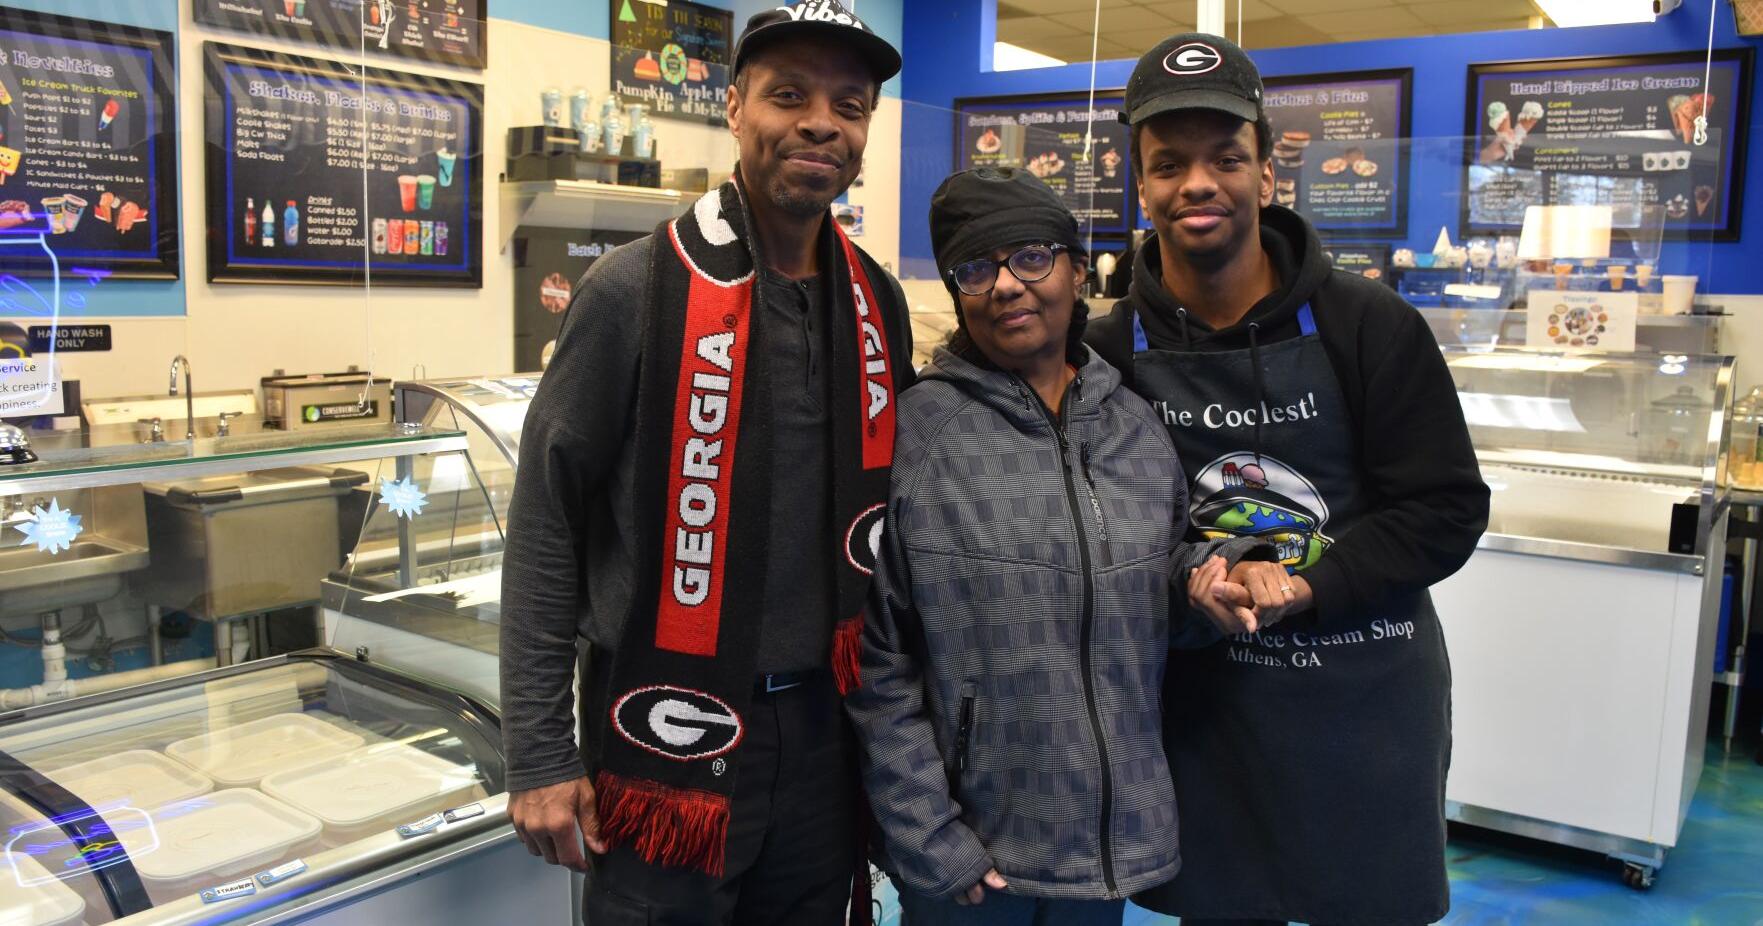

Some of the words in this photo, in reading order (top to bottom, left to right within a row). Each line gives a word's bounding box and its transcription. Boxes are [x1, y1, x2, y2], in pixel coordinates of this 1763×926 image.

[22, 78, 36, 88] Ice
[39, 79, 69, 90] Cream
[71, 83, 96, 94] Truck
[97, 86, 138, 99] Favorites
[680, 82, 713, 102] Apple
[1510, 80, 1551, 96] Hand
[1554, 78, 1609, 95] Dipped
[1612, 78, 1638, 91] Ice
[1642, 76, 1700, 89] Cream
[383, 99, 396, 115] &
[400, 102, 451, 122] Drinks
[656, 99, 675, 113] Pie
[681, 100, 692, 113] of
[37, 137, 61, 145] Cream
[237, 150, 258, 160] Soda
[307, 206, 335, 215] Canned
[307, 216, 335, 225] Bottled
[37, 329, 69, 338] HAND
[71, 328, 104, 338] WASH
[56, 339, 85, 348] ONLY
[0, 363, 36, 374] ervice
[12, 382, 57, 392] creating
[672, 331, 735, 607] GEORGIA
[1292, 627, 1365, 648] Cream
[1369, 617, 1415, 641] Shop
[1226, 644, 1287, 669] Athens,
[1291, 651, 1323, 669] GA
